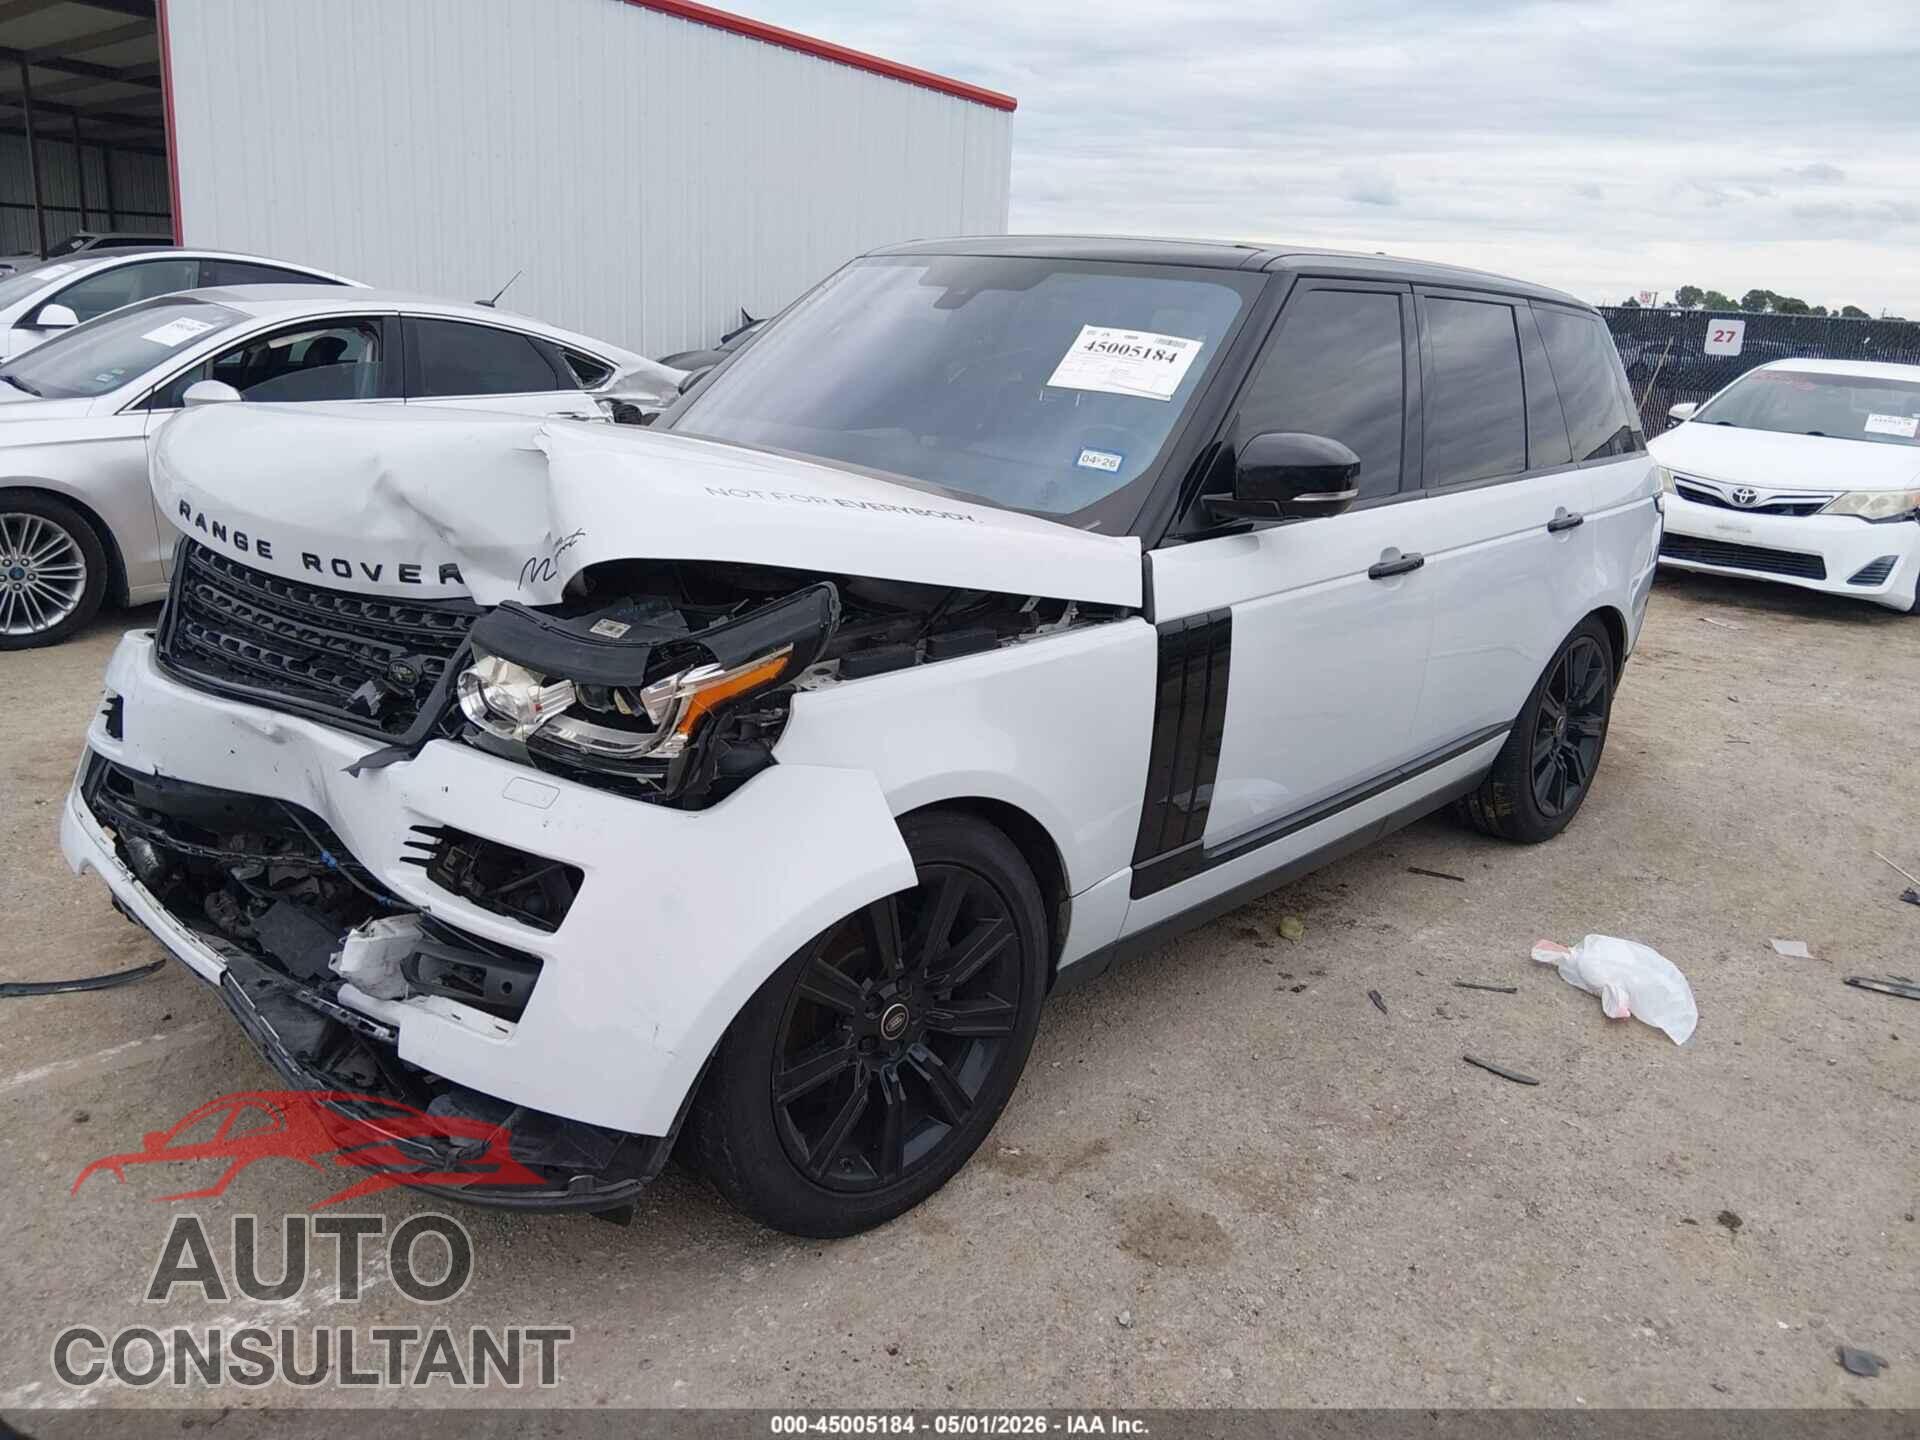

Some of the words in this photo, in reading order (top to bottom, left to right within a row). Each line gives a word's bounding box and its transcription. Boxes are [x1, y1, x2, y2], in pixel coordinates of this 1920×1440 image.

[1713, 329, 1736, 344] 27
[1083, 340, 1178, 364] 45005184
[704, 487, 763, 499] NOT
[769, 492, 830, 505] FOR
[179, 499, 273, 560] RANGE
[302, 552, 465, 585] ROVER
